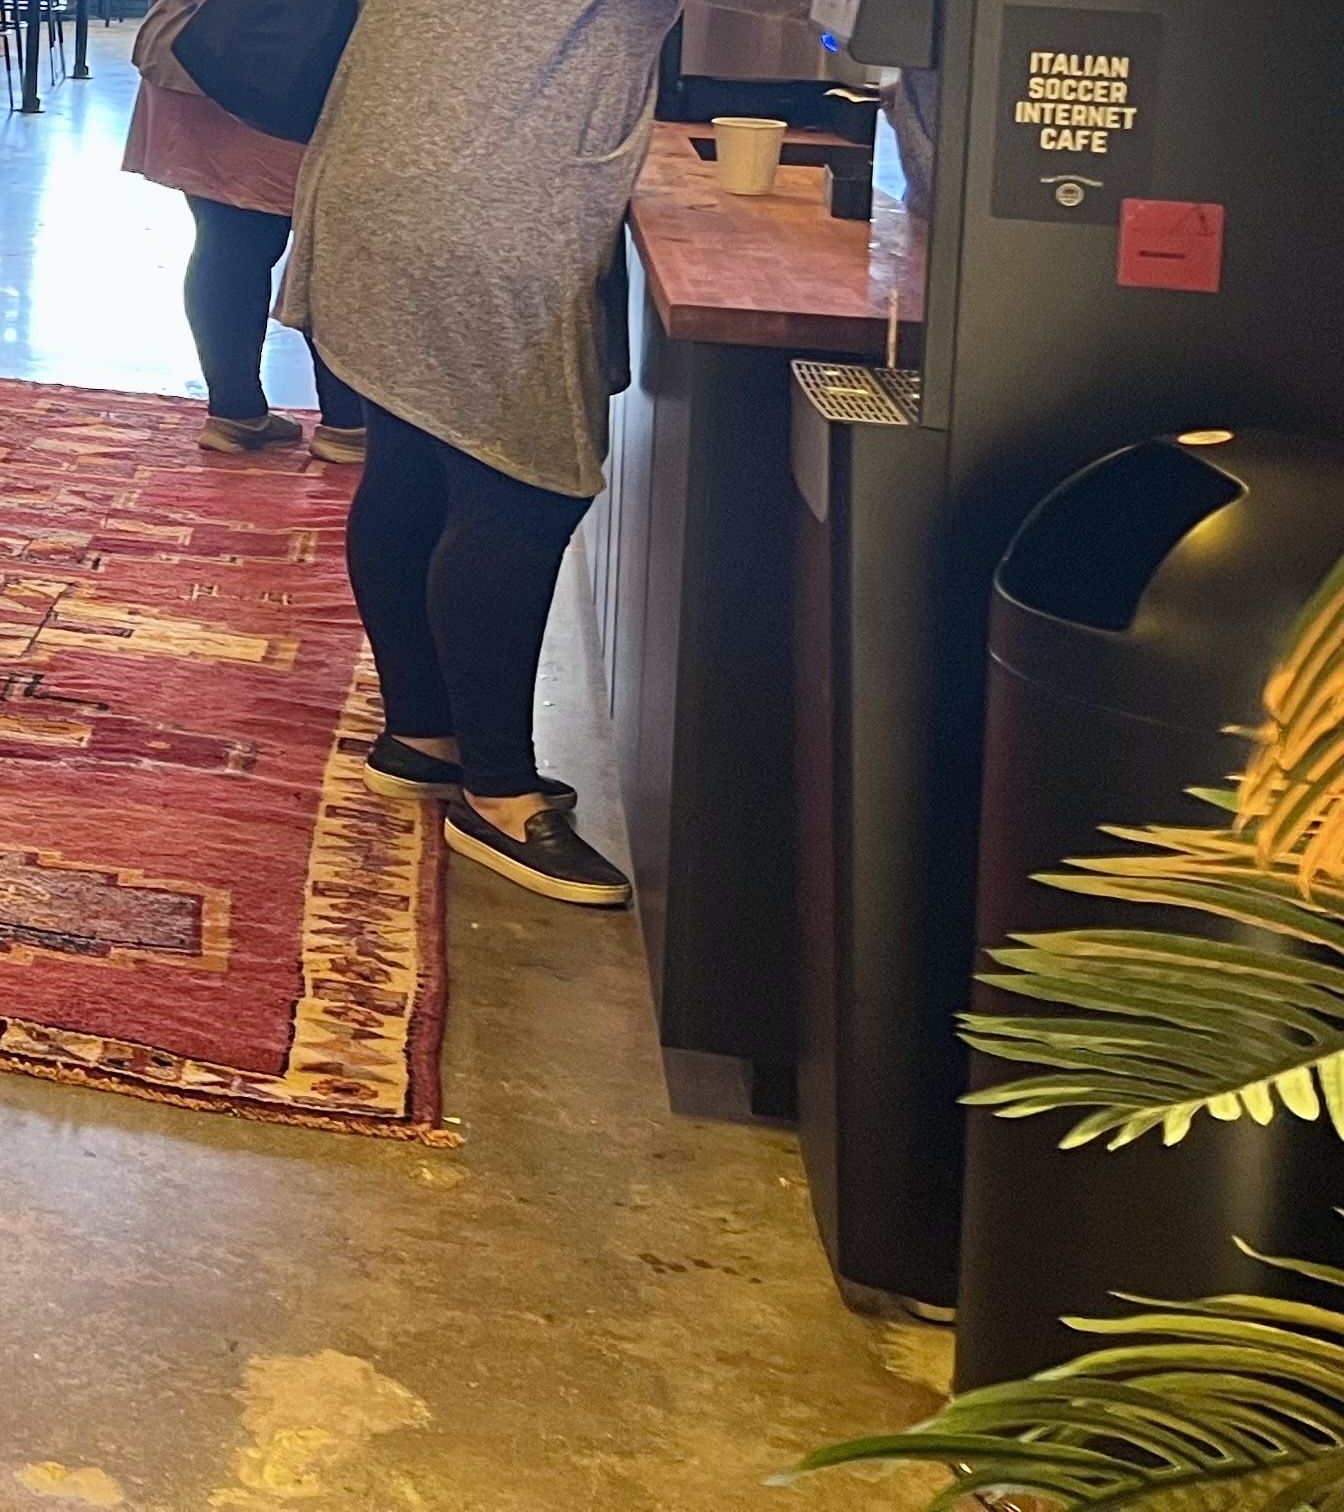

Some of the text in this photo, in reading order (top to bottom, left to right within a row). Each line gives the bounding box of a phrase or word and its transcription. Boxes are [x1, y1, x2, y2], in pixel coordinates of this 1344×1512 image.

[1030, 52, 1130, 78] ITALIAN
[1028, 77, 1128, 104] SOCCER
[1015, 101, 1137, 130] INTERNET
[1040, 128, 1109, 153] CAFE
